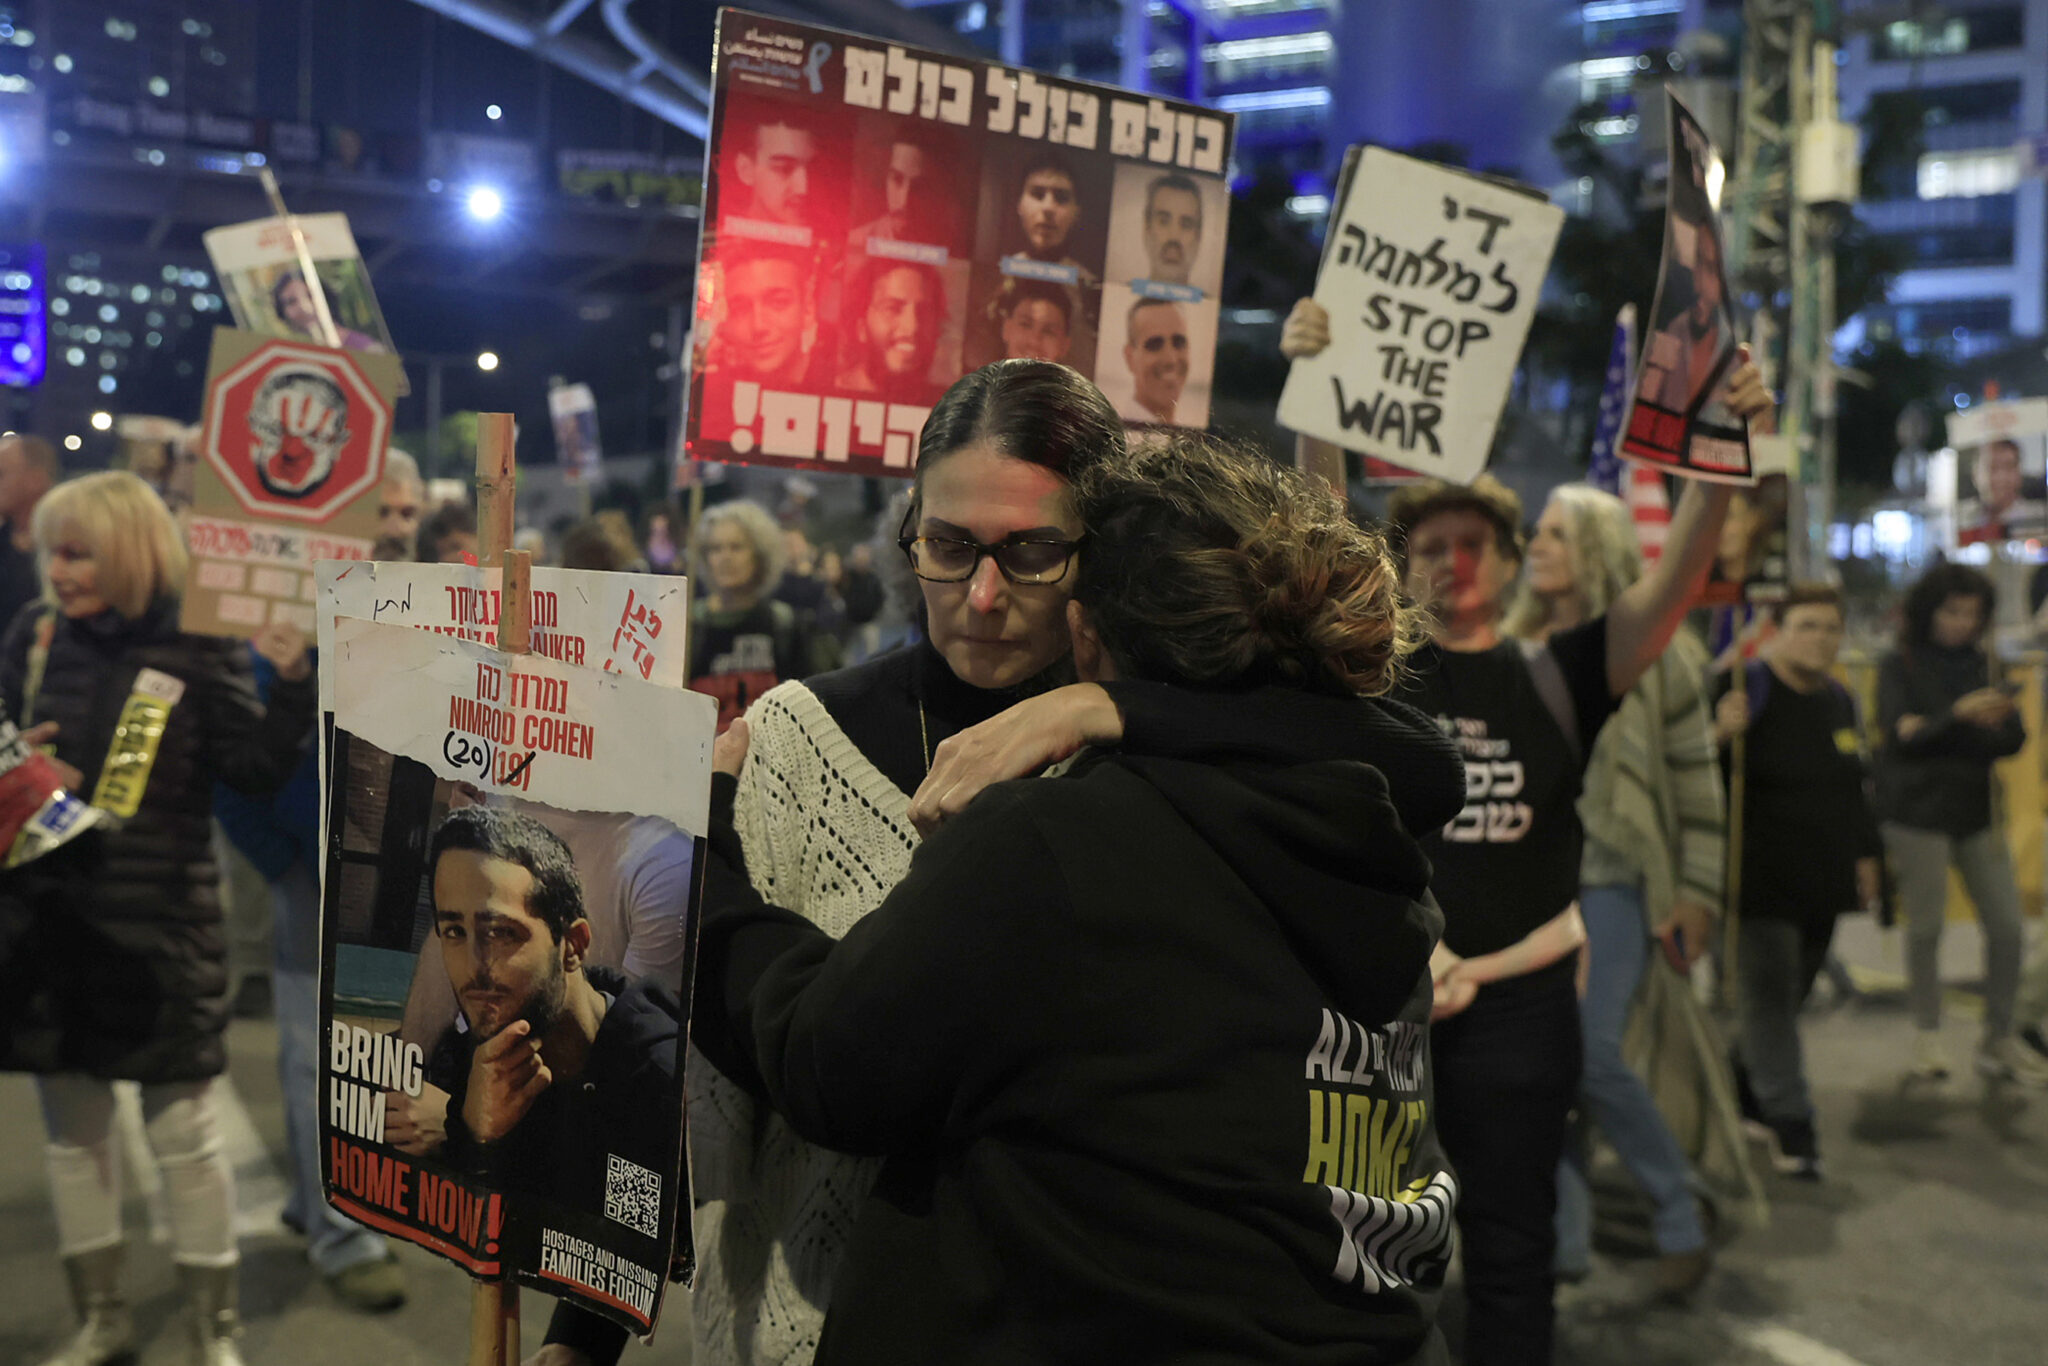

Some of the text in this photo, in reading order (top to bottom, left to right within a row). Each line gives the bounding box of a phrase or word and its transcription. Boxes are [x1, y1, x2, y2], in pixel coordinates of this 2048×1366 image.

[843, 44, 1226, 175] כולם כולל כולם
[1443, 195, 1513, 255] די
[1335, 223, 1520, 315] למלחמה
[1361, 293, 1493, 358] STOP
[1377, 344, 1449, 398] THE
[1330, 375, 1445, 457] WAR
[476, 662, 568, 715] נמרוד כהן
[443, 730, 491, 780] (20)
[449, 695, 594, 761] NIMROD COHEN
[330, 1019, 424, 1098] BRING
[1305, 1007, 1374, 1086] ALL
[330, 1076, 385, 1145] HIM
[330, 1136, 501, 1255] HOME NOW!
[540, 1245, 655, 1320] FAMILIES FORUM
[542, 1227, 659, 1292] HOSTAGES AND MISSING
